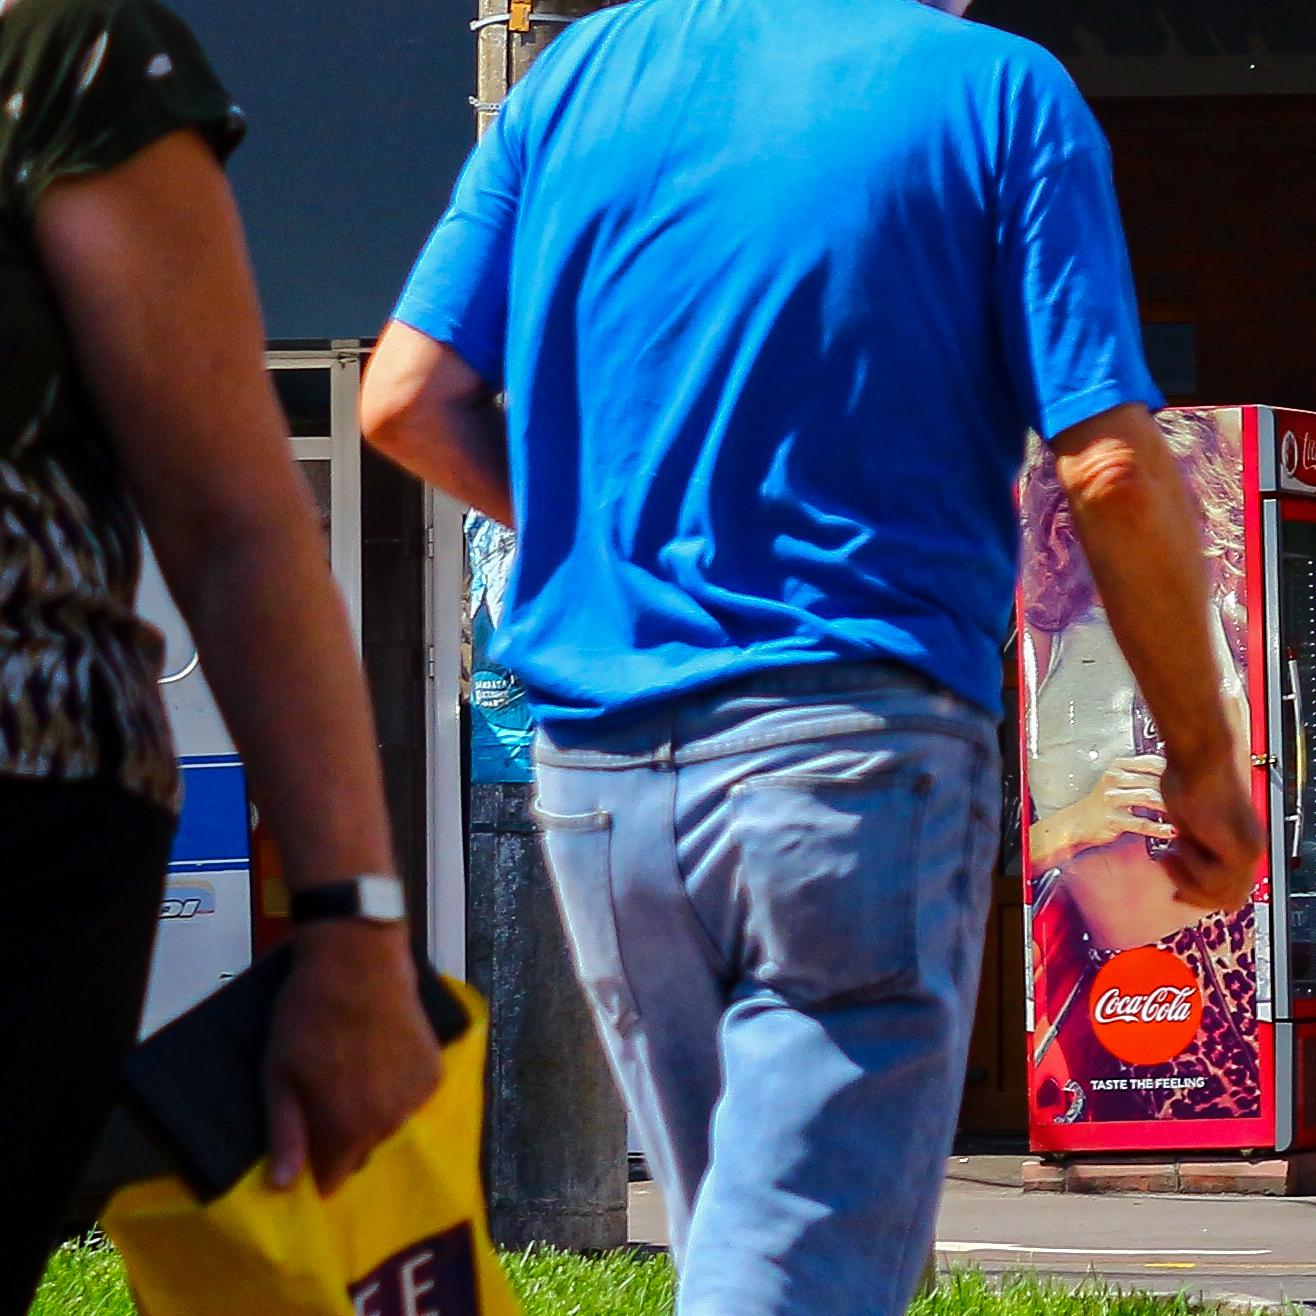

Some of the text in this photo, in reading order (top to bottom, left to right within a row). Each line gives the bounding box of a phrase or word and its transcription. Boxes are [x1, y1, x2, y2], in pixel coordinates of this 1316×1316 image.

[1094, 986, 1198, 1023] Coca-Cola
[1090, 1077, 1205, 1091] TASTE THE FEELING
